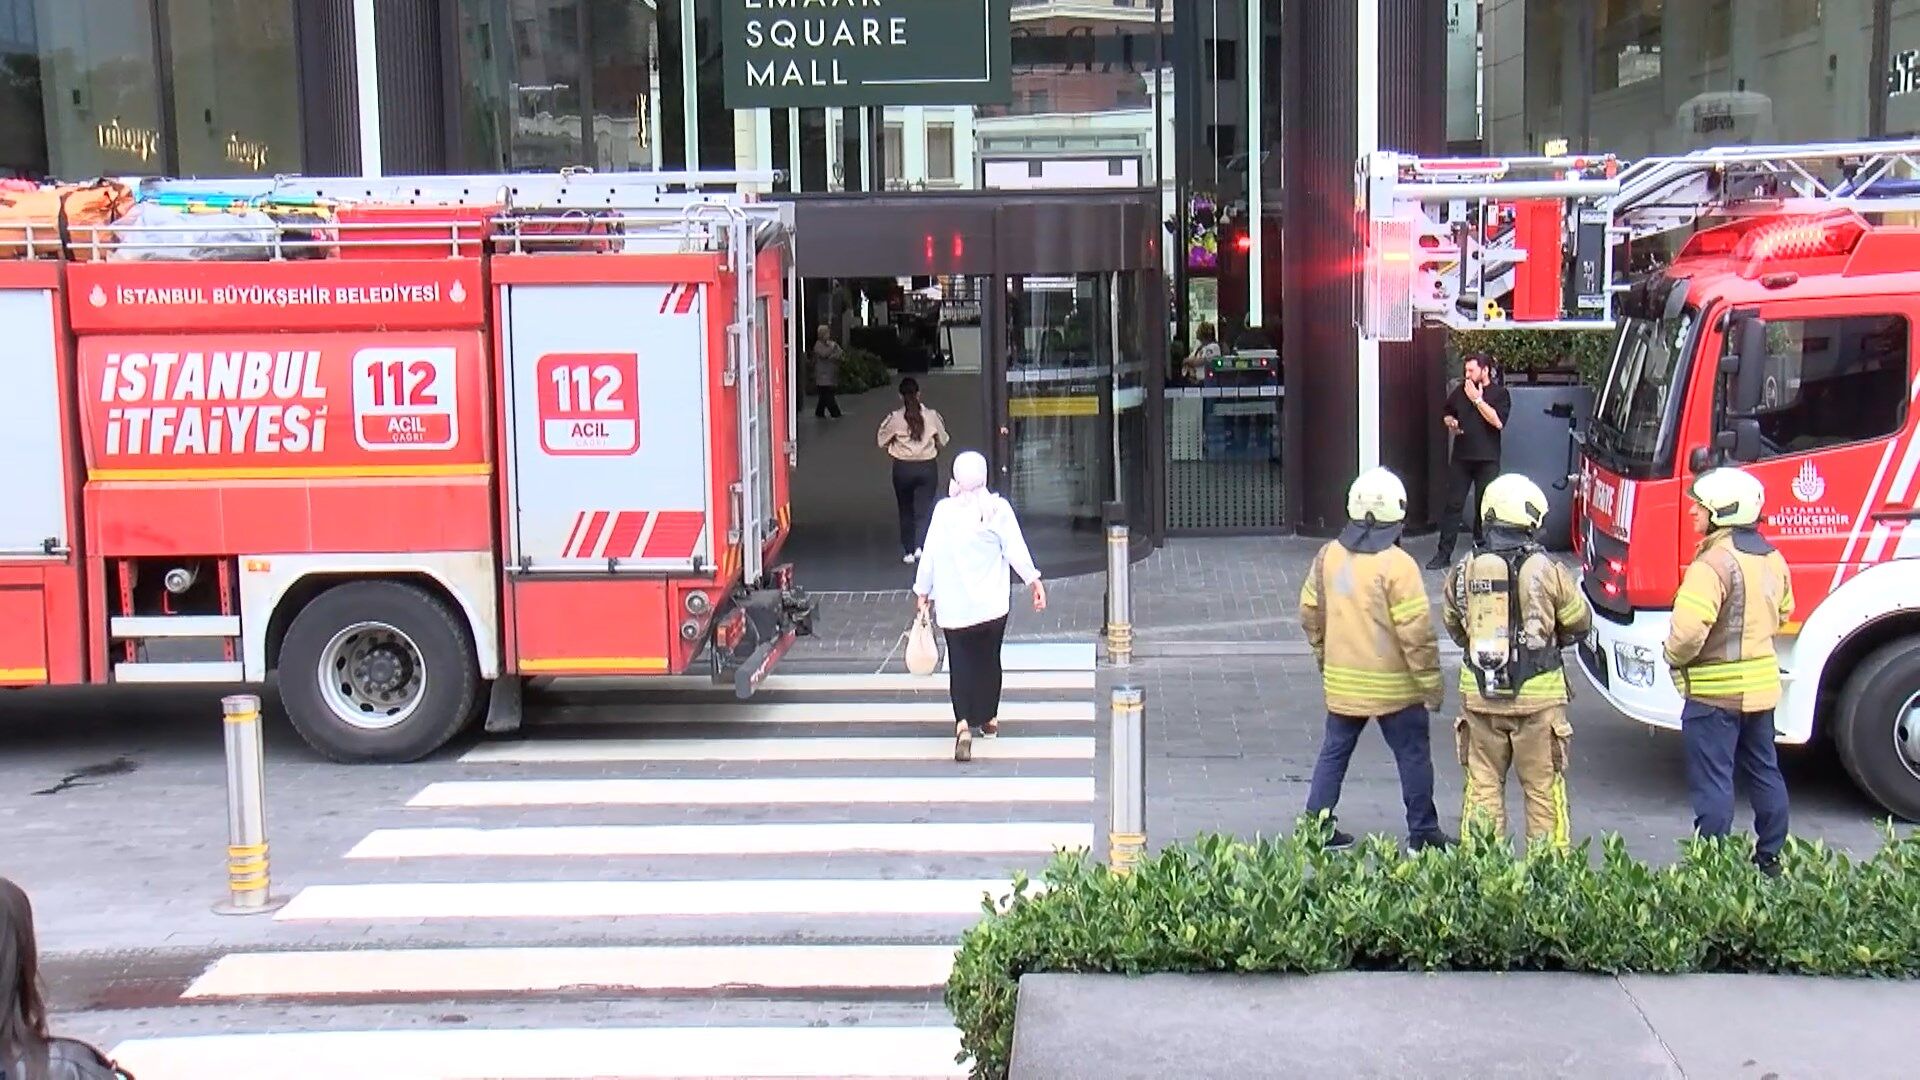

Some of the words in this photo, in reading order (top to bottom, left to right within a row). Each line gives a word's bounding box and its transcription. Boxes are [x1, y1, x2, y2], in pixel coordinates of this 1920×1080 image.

[746, 17, 908, 49] SQUARE
[746, 59, 848, 87] MALL
[116, 285, 208, 304] İSTANBUL
[212, 284, 331, 308] BÜYÜKŞEHİR
[336, 281, 440, 304] BELEDİYESİ
[367, 361, 438, 406] 112
[551, 364, 625, 412] 112
